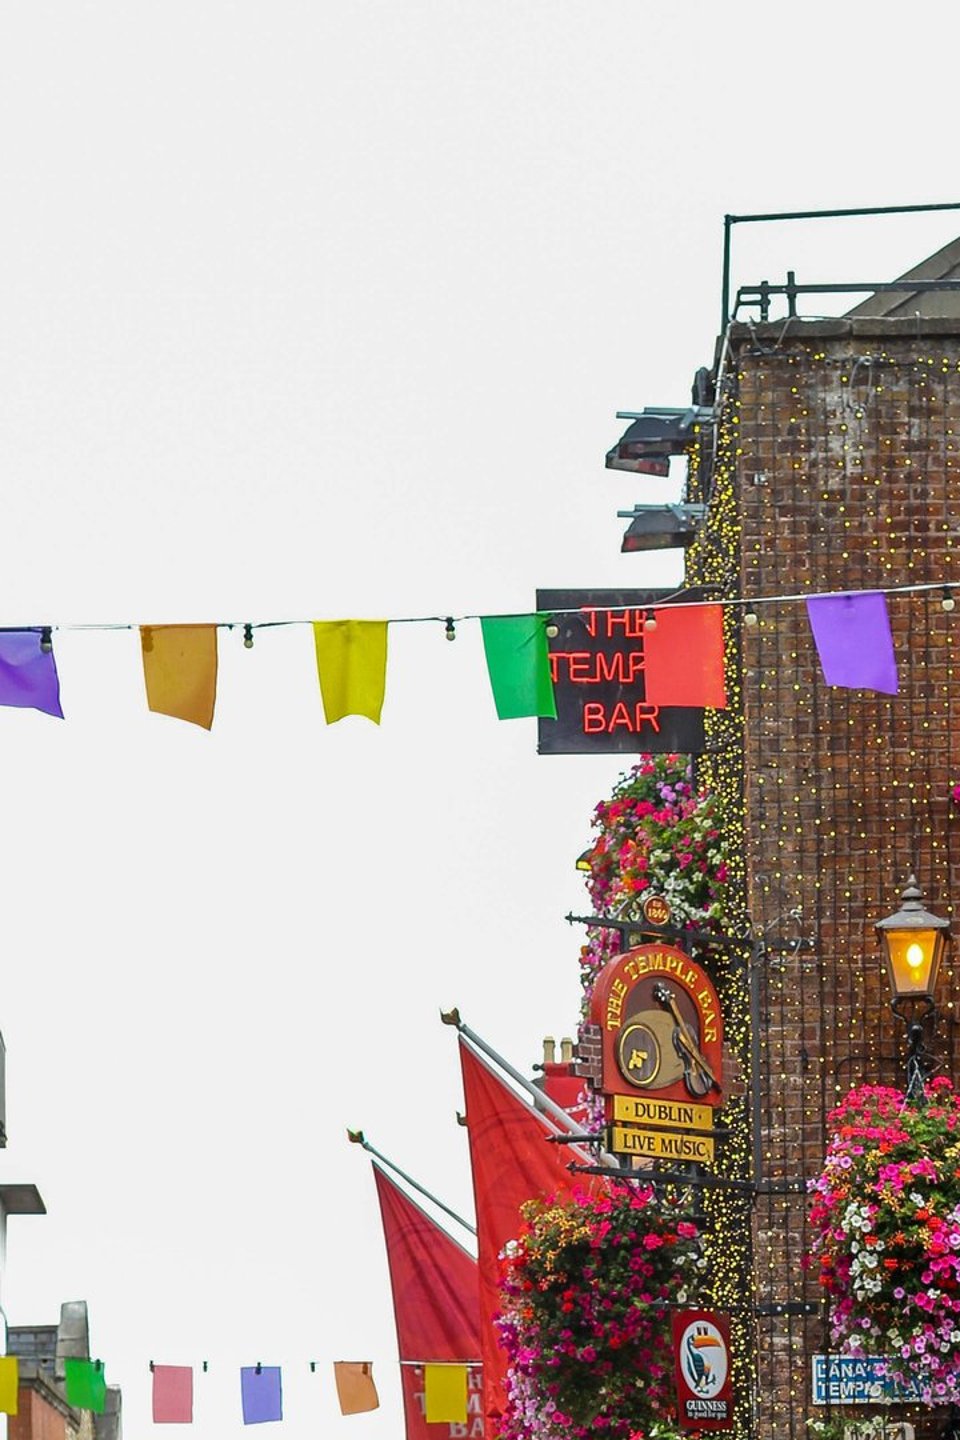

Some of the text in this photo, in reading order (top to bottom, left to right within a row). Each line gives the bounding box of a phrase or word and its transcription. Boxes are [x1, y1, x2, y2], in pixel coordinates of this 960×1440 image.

[548, 652, 646, 683] TEMP
[583, 702, 660, 733] BAR
[607, 952, 717, 1044] THE TEMPLE BAR
[634, 1102, 694, 1124] DUBLIN
[623, 1133, 707, 1158] LIVE MUSIC
[686, 1400, 727, 1411] GUINNESS
[449, 1418, 485, 1438] BA
